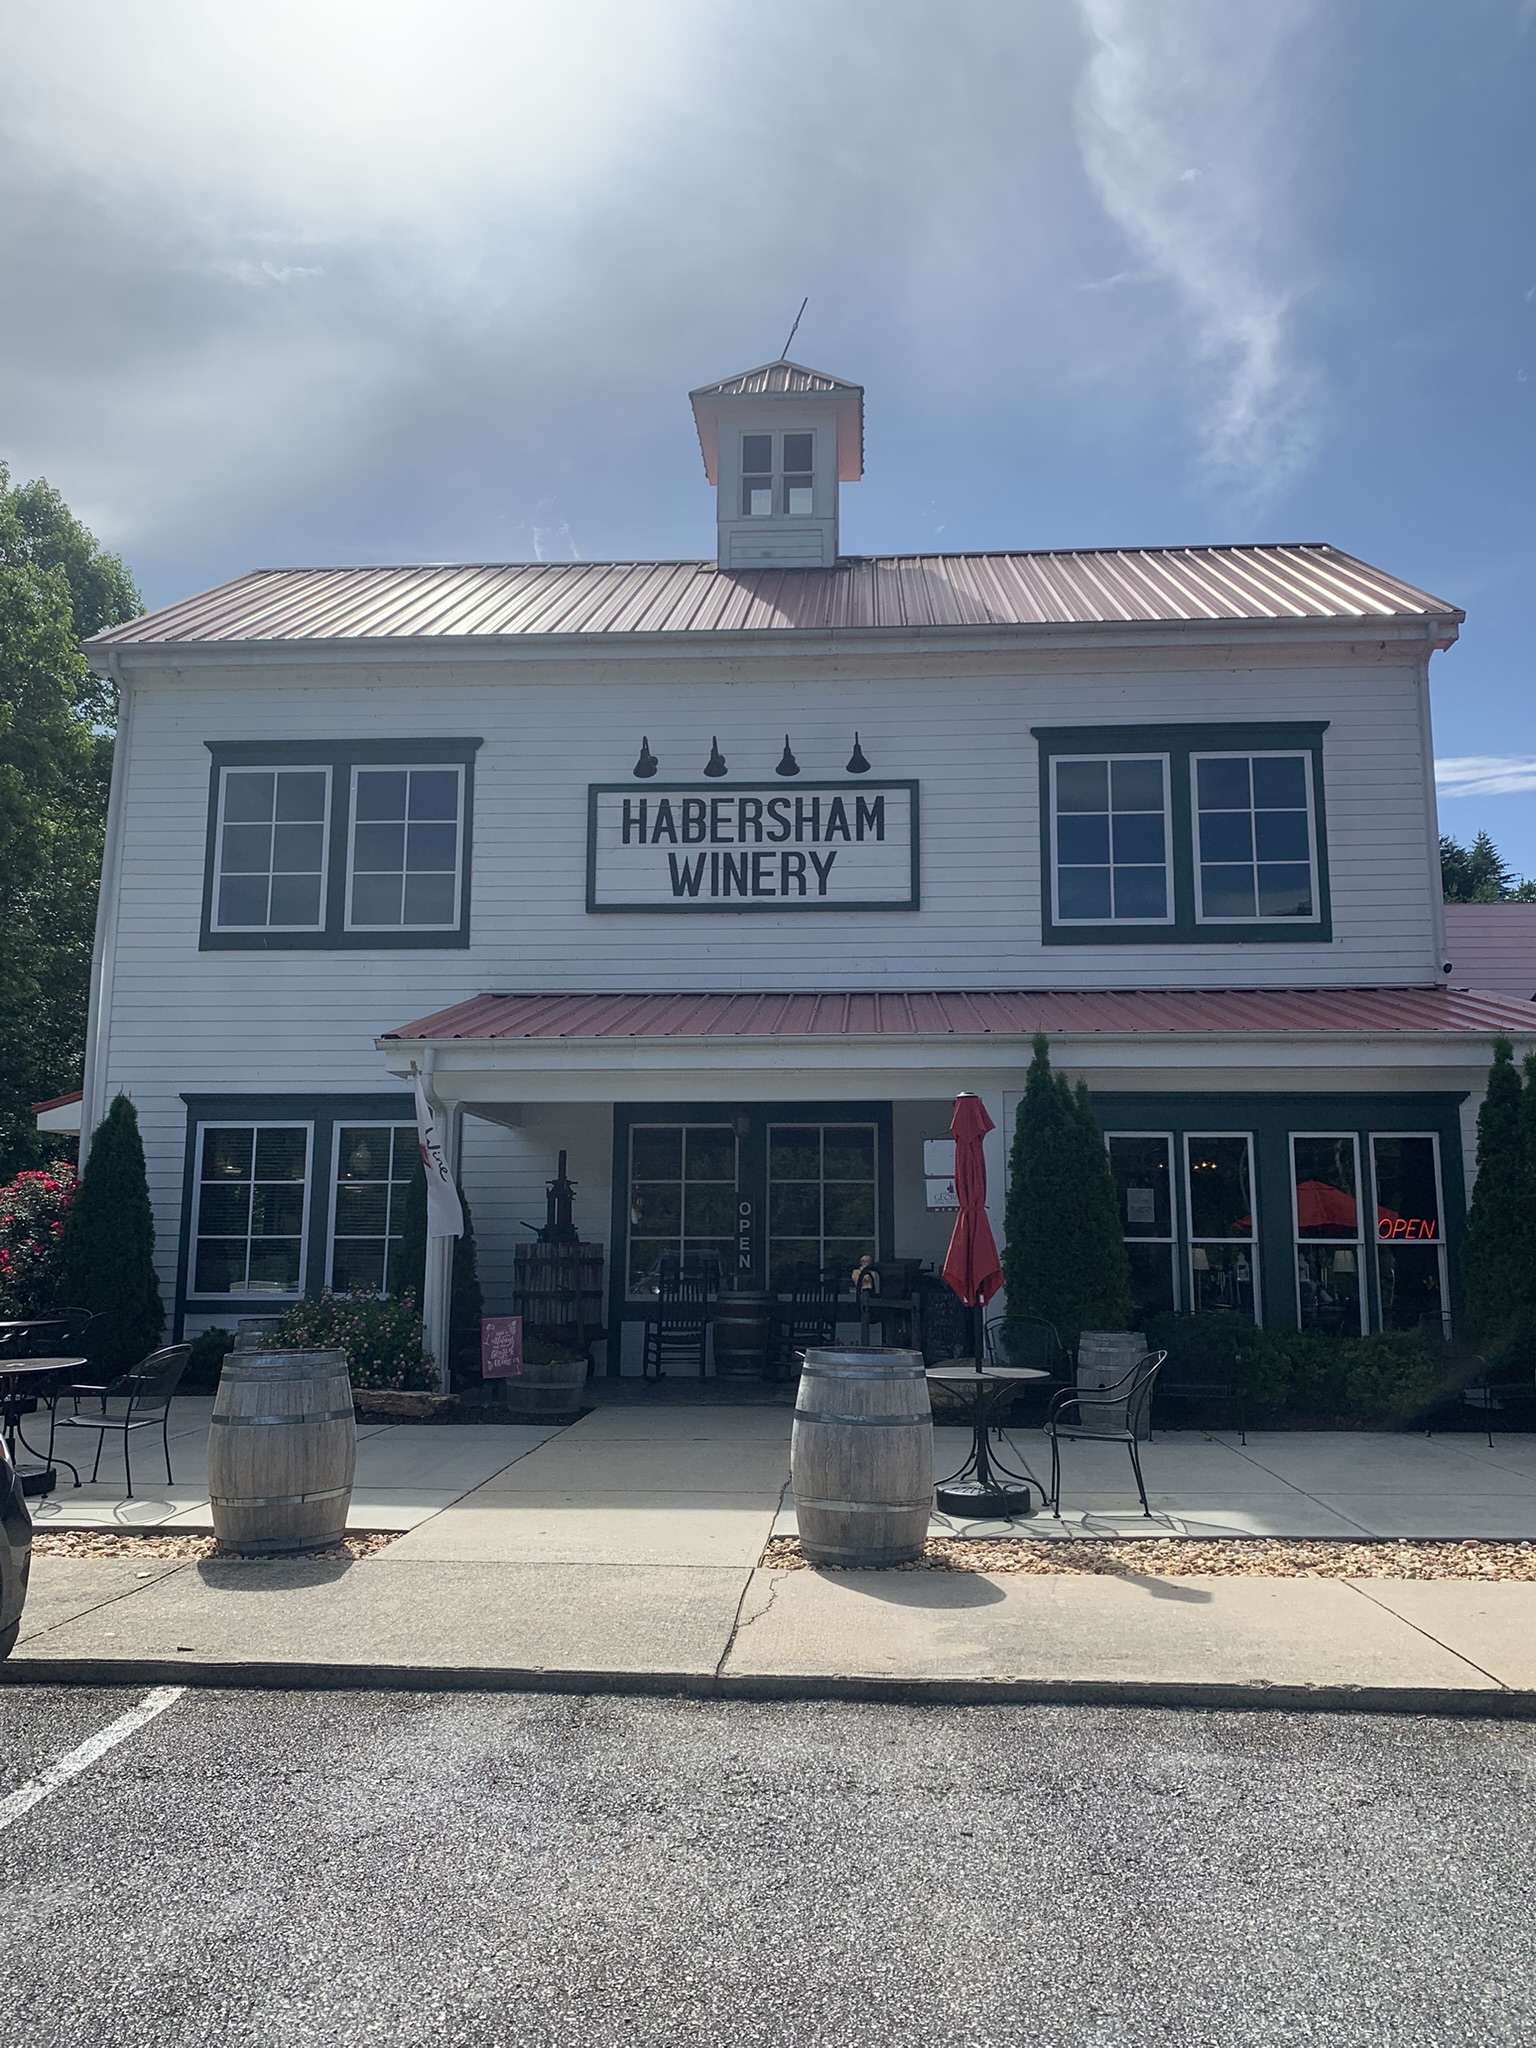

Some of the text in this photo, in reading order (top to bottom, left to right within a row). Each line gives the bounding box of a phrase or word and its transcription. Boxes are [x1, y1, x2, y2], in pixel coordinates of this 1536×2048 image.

[622, 795, 885, 844] HABERSHAM
[668, 850, 838, 897] WINERY
[425, 1127, 448, 1182] Wine
[934, 1193, 958, 1201] GEOR
[739, 1202, 751, 1268] OPEN
[1378, 1218, 1436, 1239] OPEN
